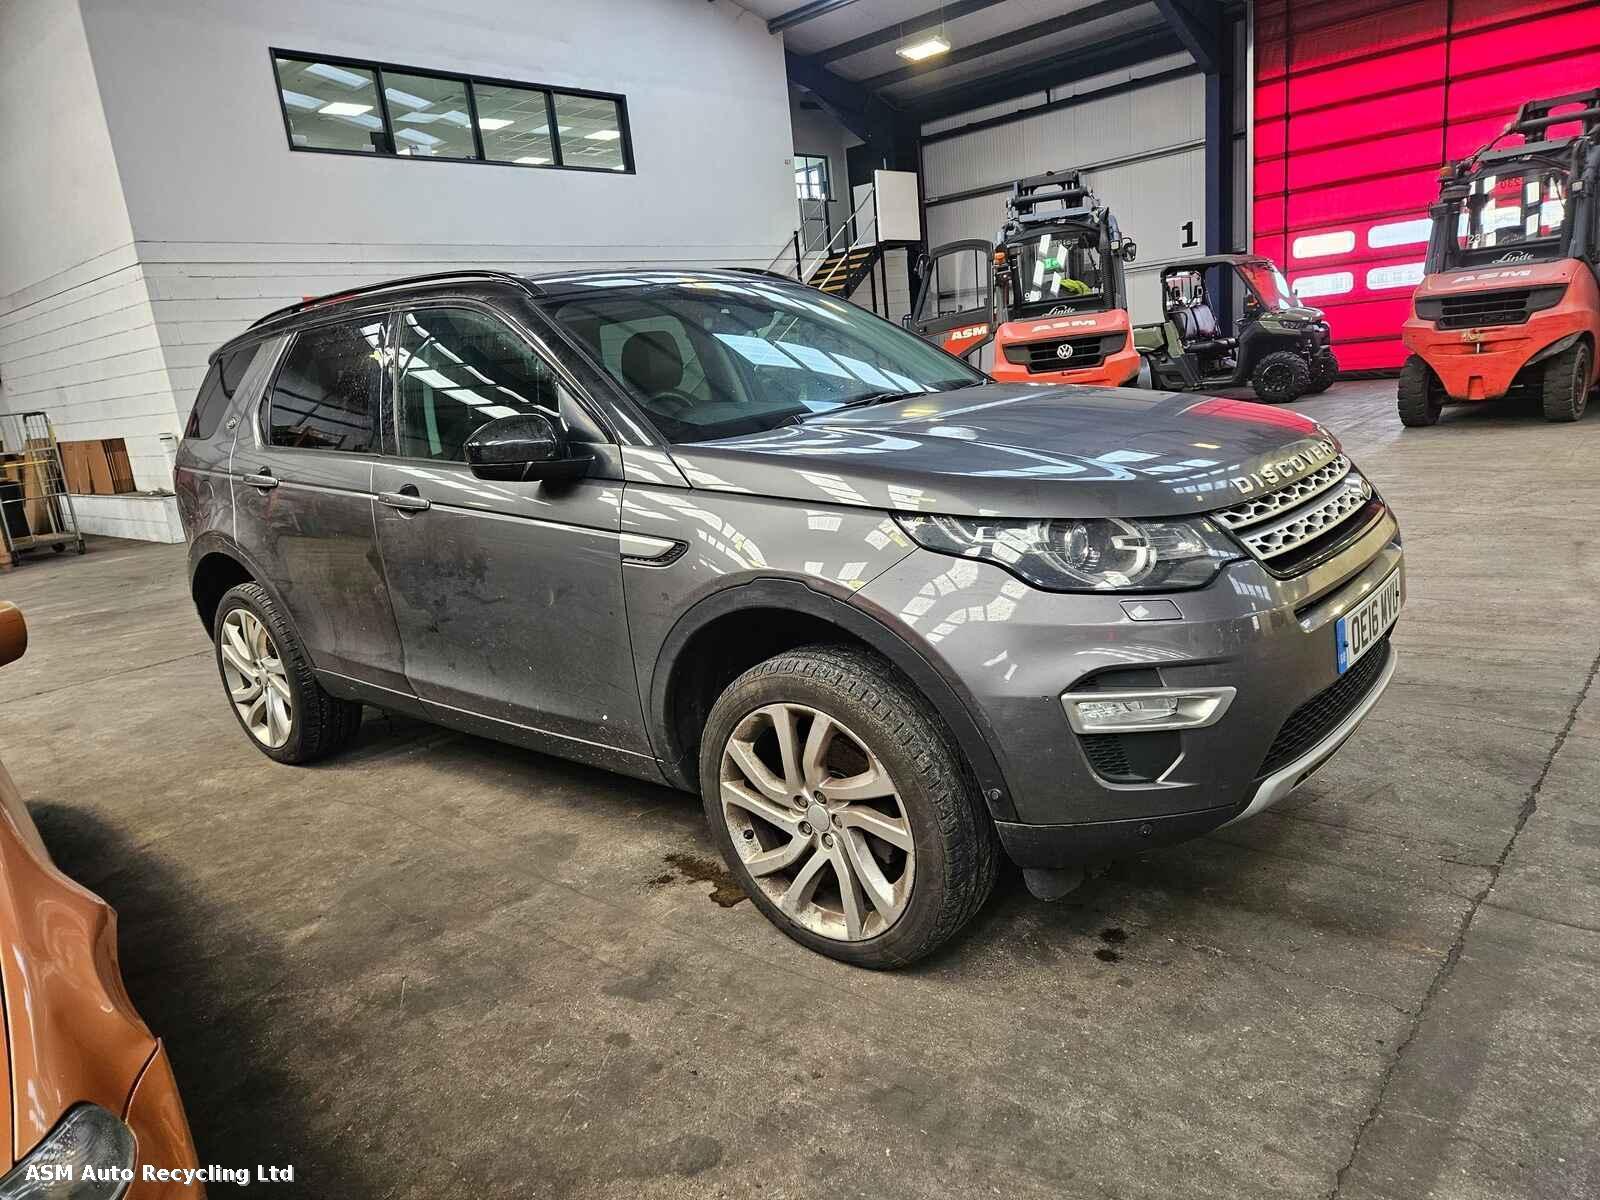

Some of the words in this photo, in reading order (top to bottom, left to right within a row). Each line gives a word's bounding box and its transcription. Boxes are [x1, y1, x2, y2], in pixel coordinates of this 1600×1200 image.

[1181, 221, 1198, 249] 1
[1492, 250, 1535, 264] Linde
[1452, 269, 1532, 284] ASM
[1041, 304, 1076, 319] Linde
[951, 325, 988, 341] ASM
[1031, 319, 1097, 333] ASM
[1230, 437, 1336, 493] DISCOVERY
[1351, 599, 1379, 655] OE16
